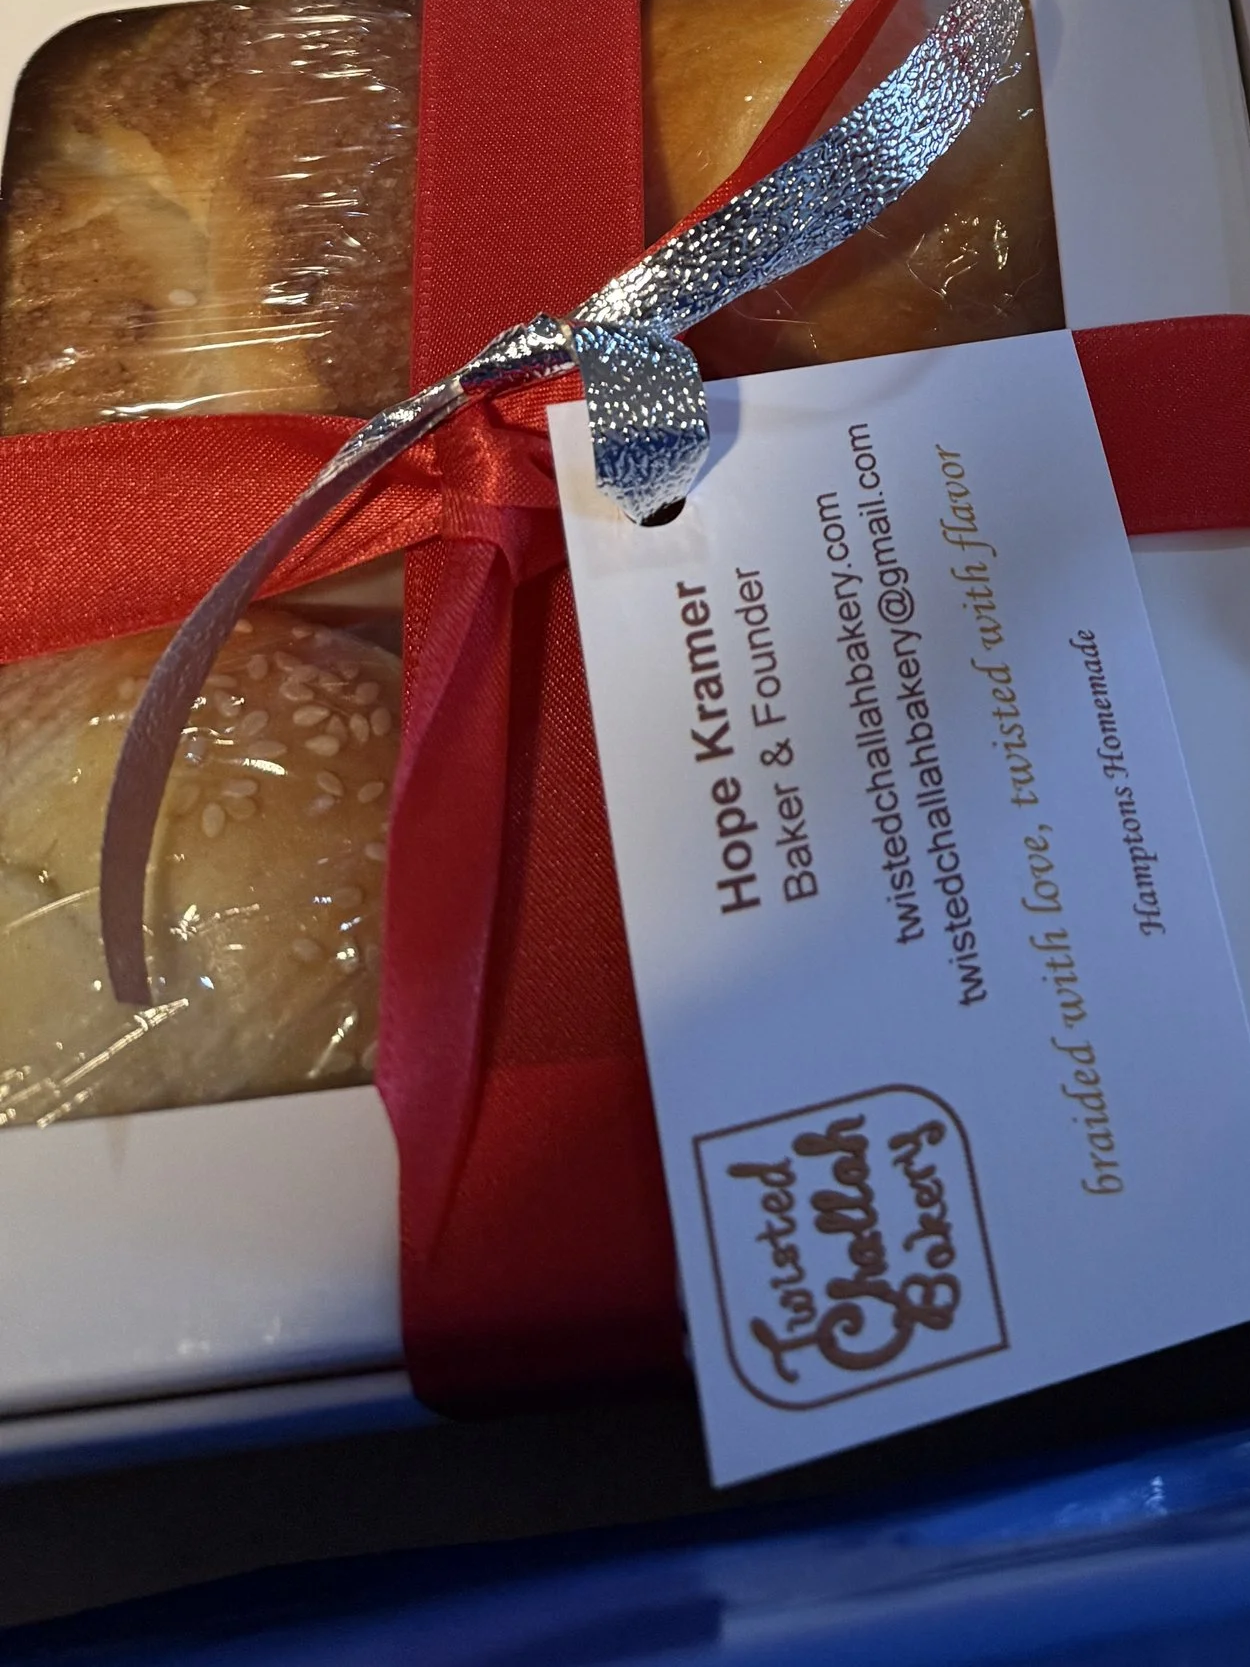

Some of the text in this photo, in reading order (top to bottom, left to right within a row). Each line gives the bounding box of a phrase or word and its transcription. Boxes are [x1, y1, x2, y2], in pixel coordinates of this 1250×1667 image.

[675, 580, 762, 916] Hope Kramer
[734, 567, 819, 903] Baker & Founder
[816, 492, 924, 945] twistedchallahbakery.com
[848, 423, 988, 1007] twistedchallahbakery@gmail.com
[934, 444, 1125, 1196] braided with love, twisted with flavor
[1069, 629, 1166, 937] Hamptons Homemade
[727, 1160, 822, 1381] Twisted
[793, 1115, 911, 1371] Challah
[888, 1122, 960, 1331] Bakery
